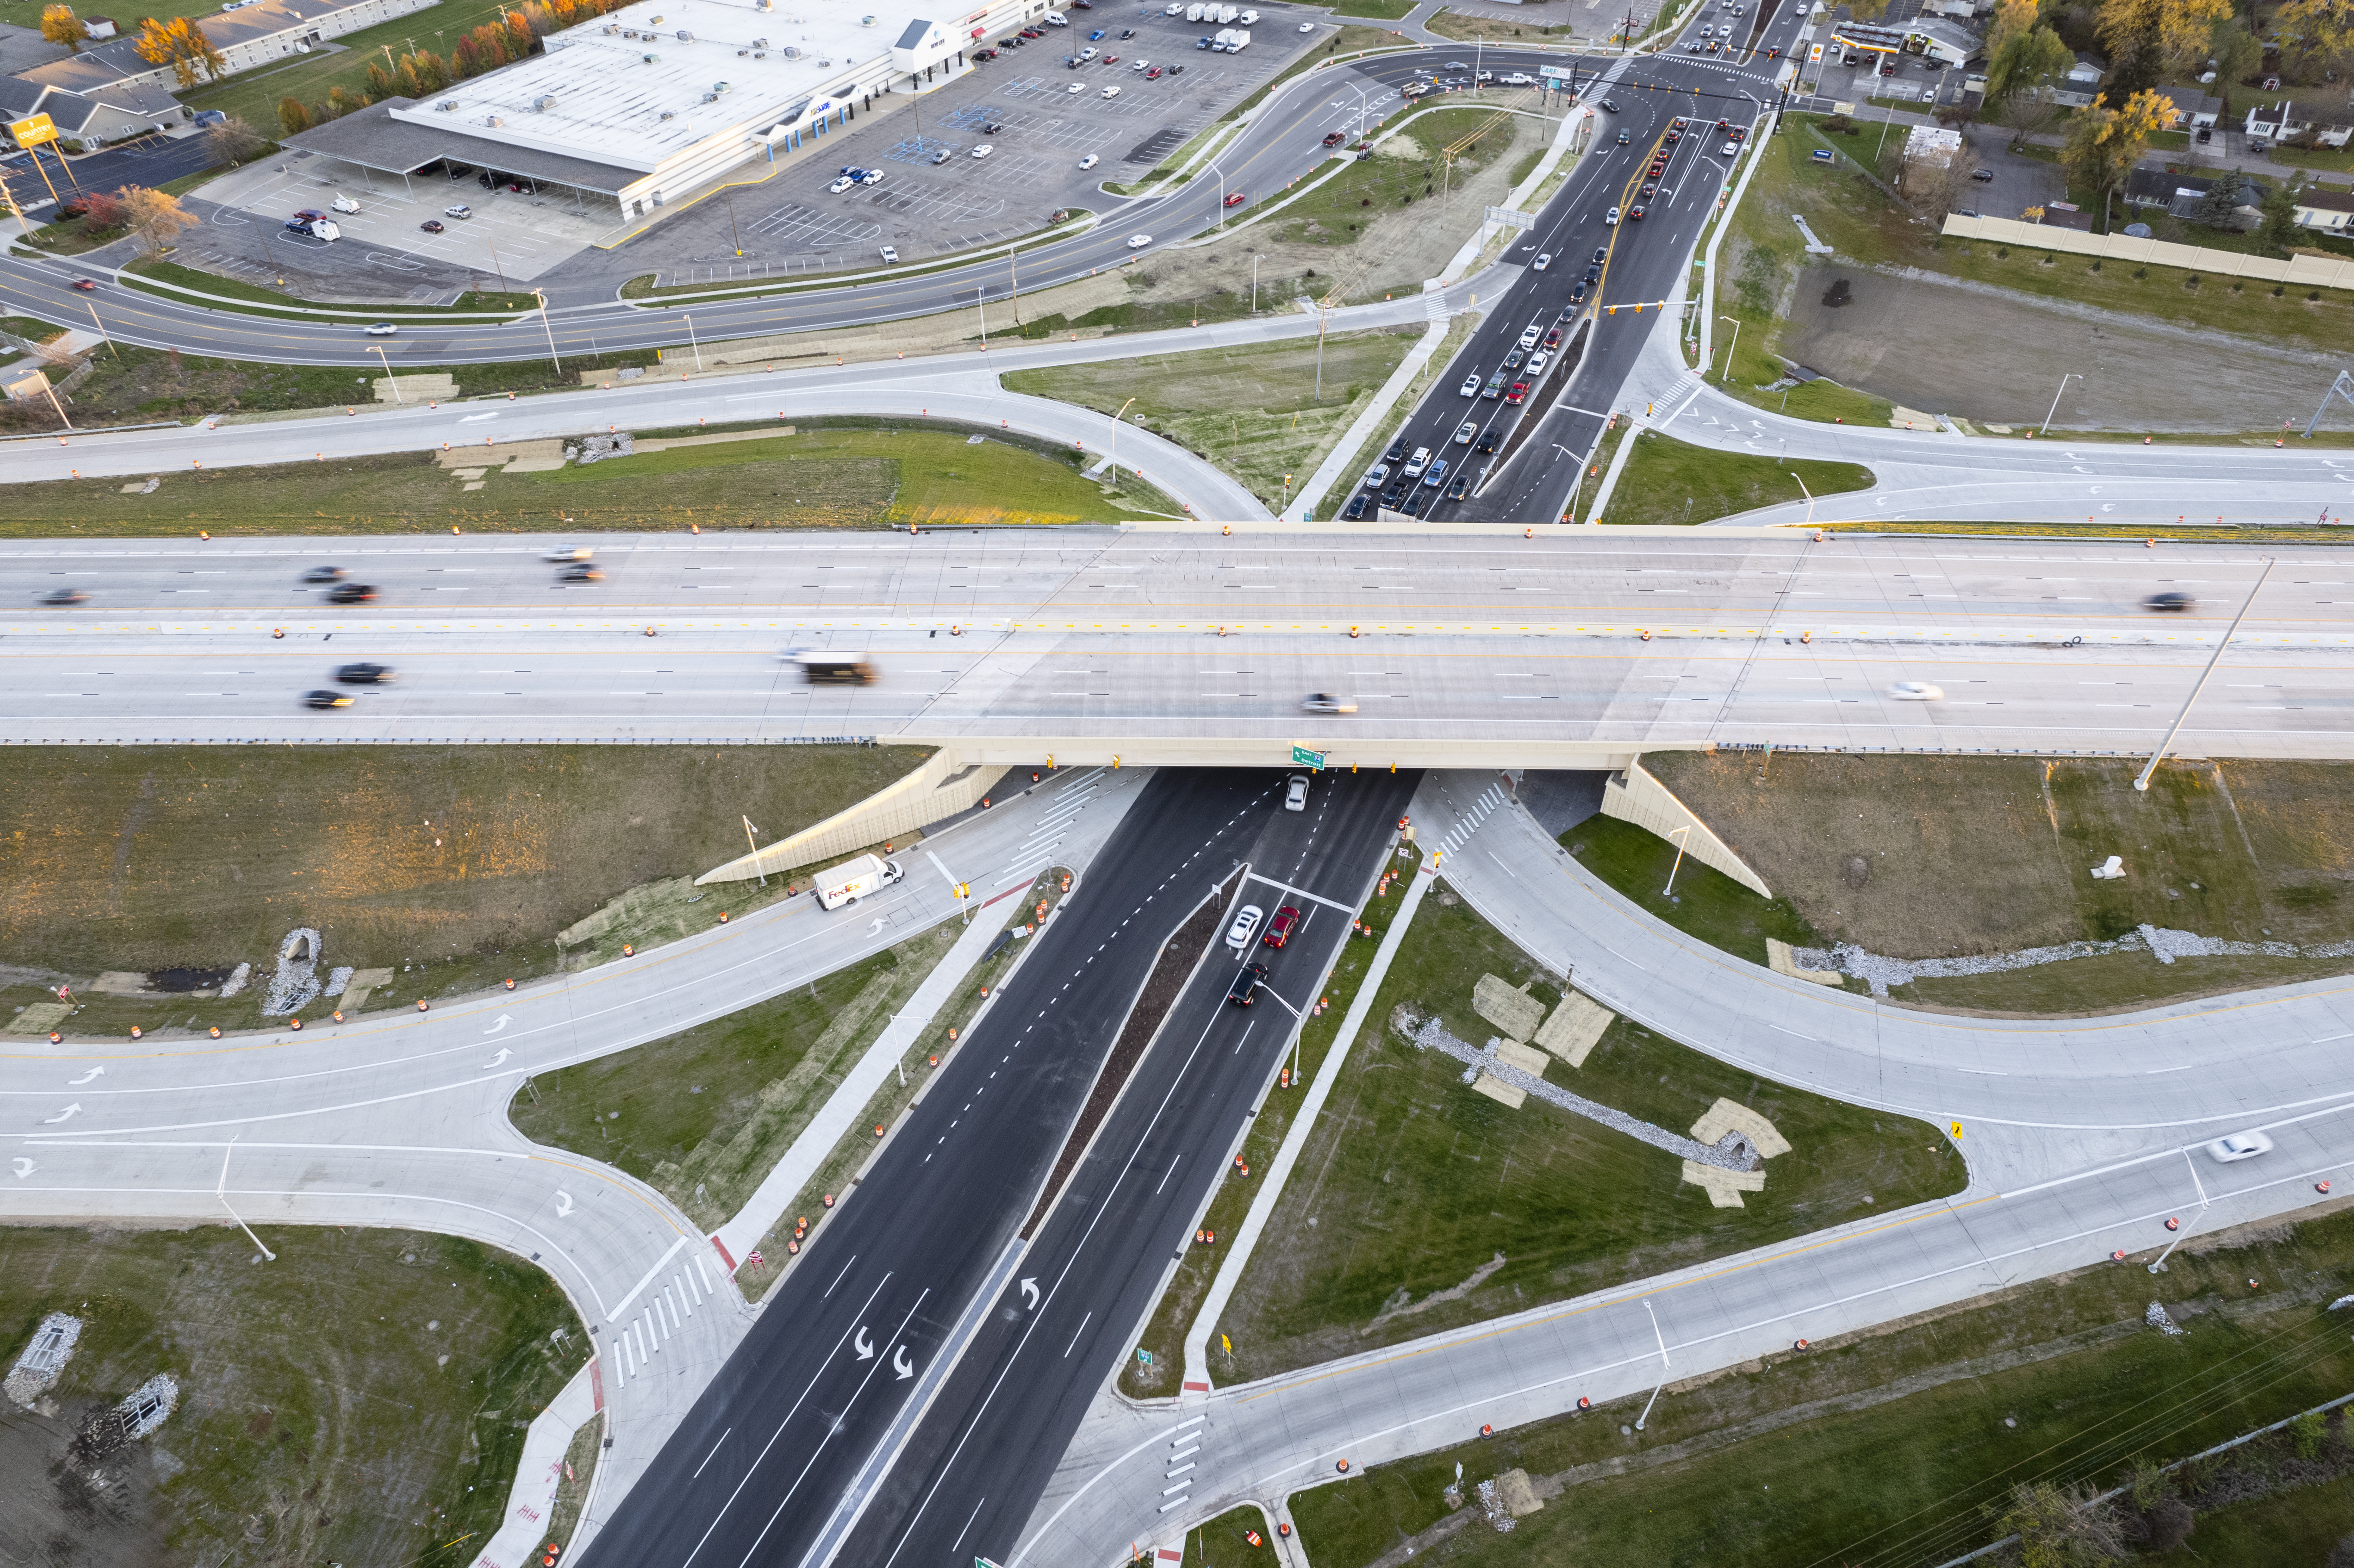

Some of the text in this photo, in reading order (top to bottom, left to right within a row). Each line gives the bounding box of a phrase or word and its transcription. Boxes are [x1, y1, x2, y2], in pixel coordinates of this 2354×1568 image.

[18, 124, 51, 139] COUNTRY
[1301, 758, 1321, 767] Detroit
[828, 883, 861, 899] FedEx
